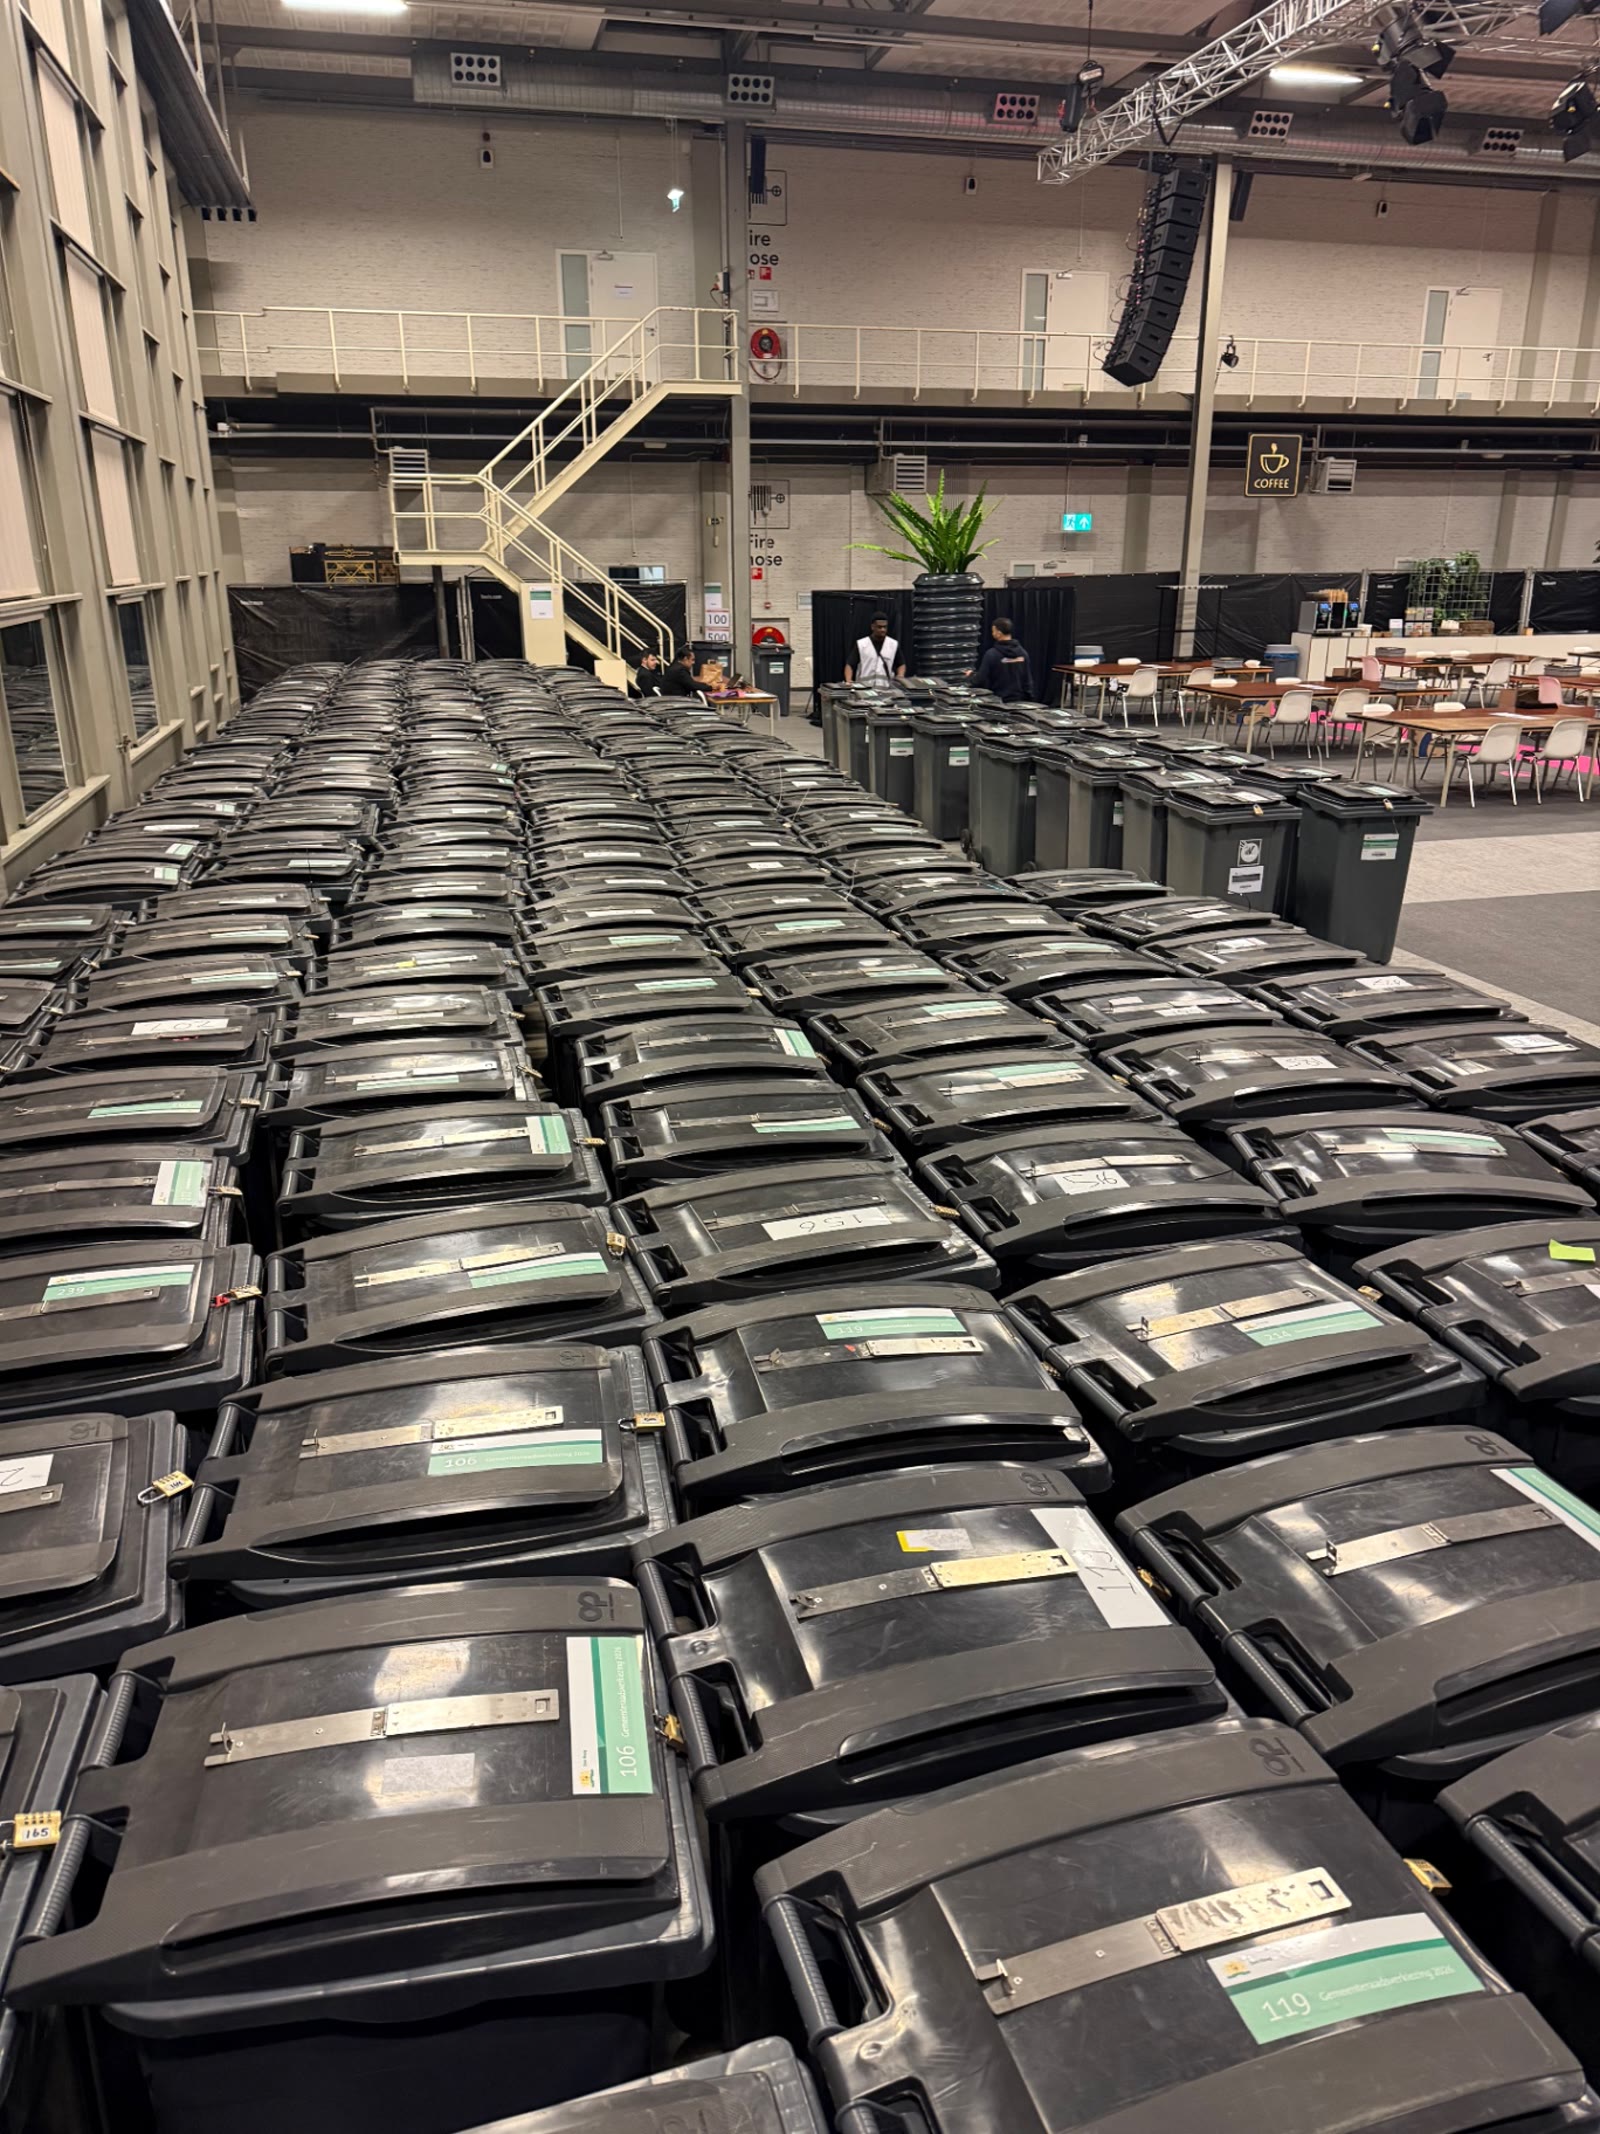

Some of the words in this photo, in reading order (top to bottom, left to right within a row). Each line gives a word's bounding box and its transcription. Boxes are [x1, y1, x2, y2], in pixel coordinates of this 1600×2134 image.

[749, 229, 771, 246] ire
[750, 253, 779, 266] ose
[1254, 478, 1290, 489] COFFEE
[709, 614, 727, 625] 100
[57, 1286, 85, 1296] 239
[837, 1325, 864, 1335] 119
[1264, 1330, 1292, 1341] 214
[444, 1456, 478, 1468] 106
[616, 1745, 637, 1777] 106
[26, 1828, 49, 1839] 165
[1261, 1991, 1312, 2022] 119
[1319, 1970, 1435, 2001] Gemeenteraadsverkiezing
